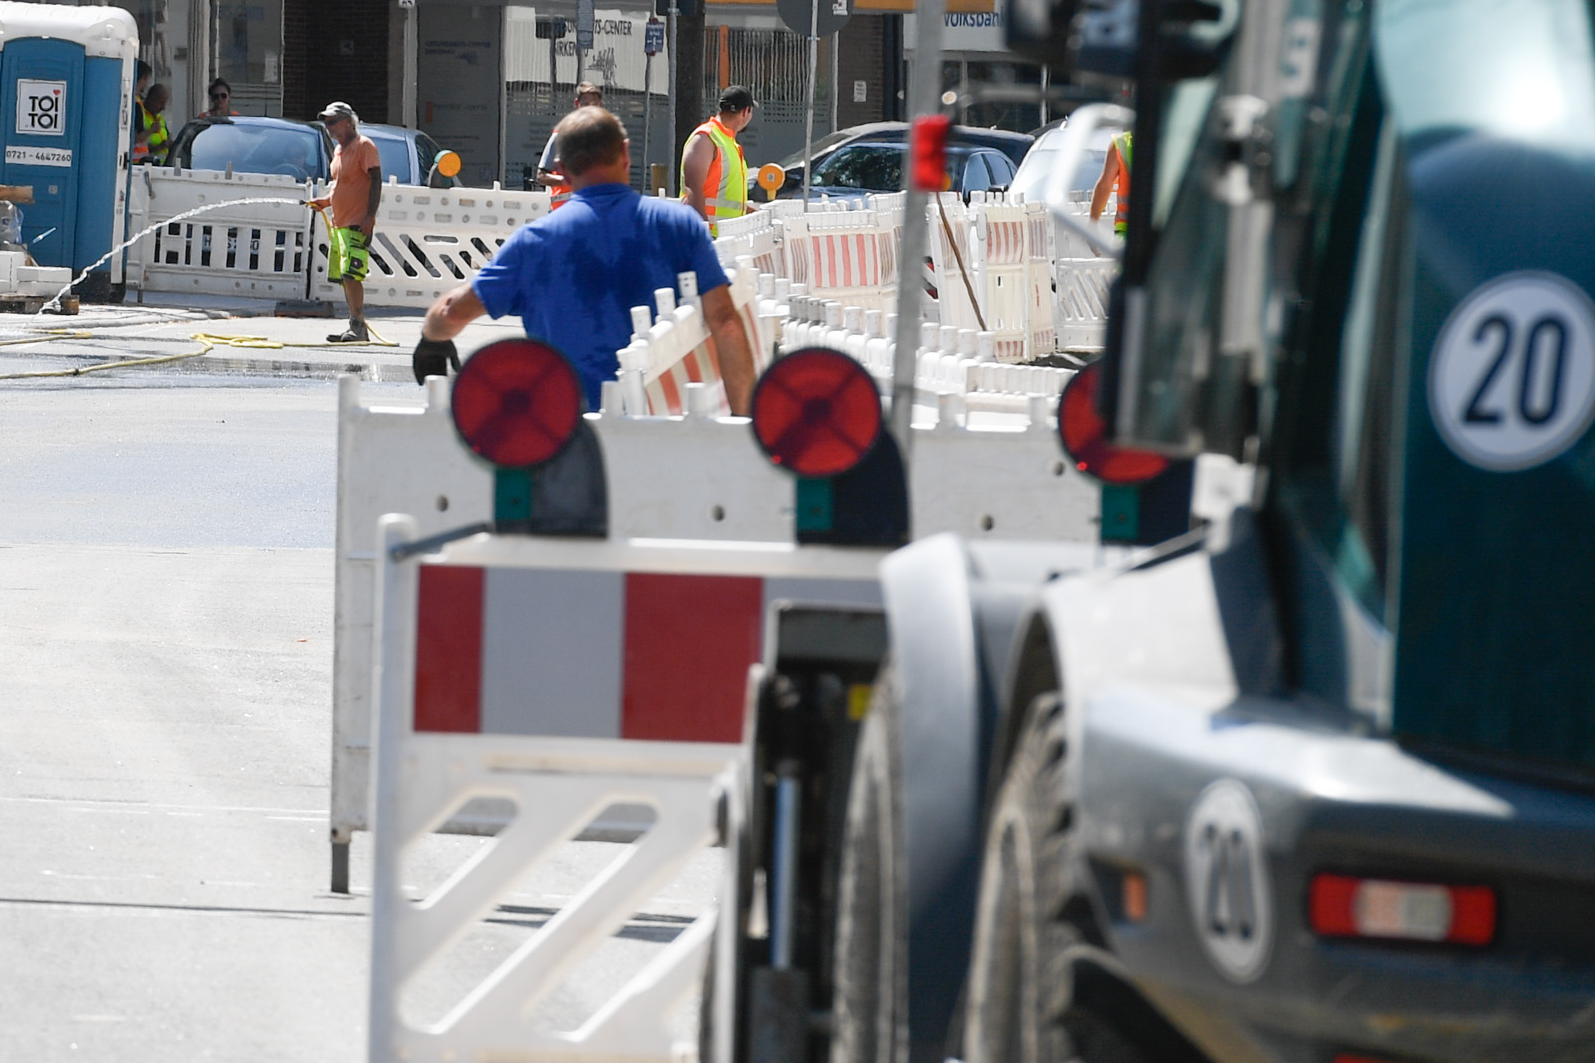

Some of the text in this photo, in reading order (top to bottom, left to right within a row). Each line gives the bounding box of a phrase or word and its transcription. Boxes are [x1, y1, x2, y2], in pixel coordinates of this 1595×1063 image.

[944, 7, 1006, 28] Volksban
[28, 95, 58, 112] TOI
[28, 113, 58, 129] TOI
[6, 150, 26, 160] 0721
[1462, 307, 1570, 428] 20
